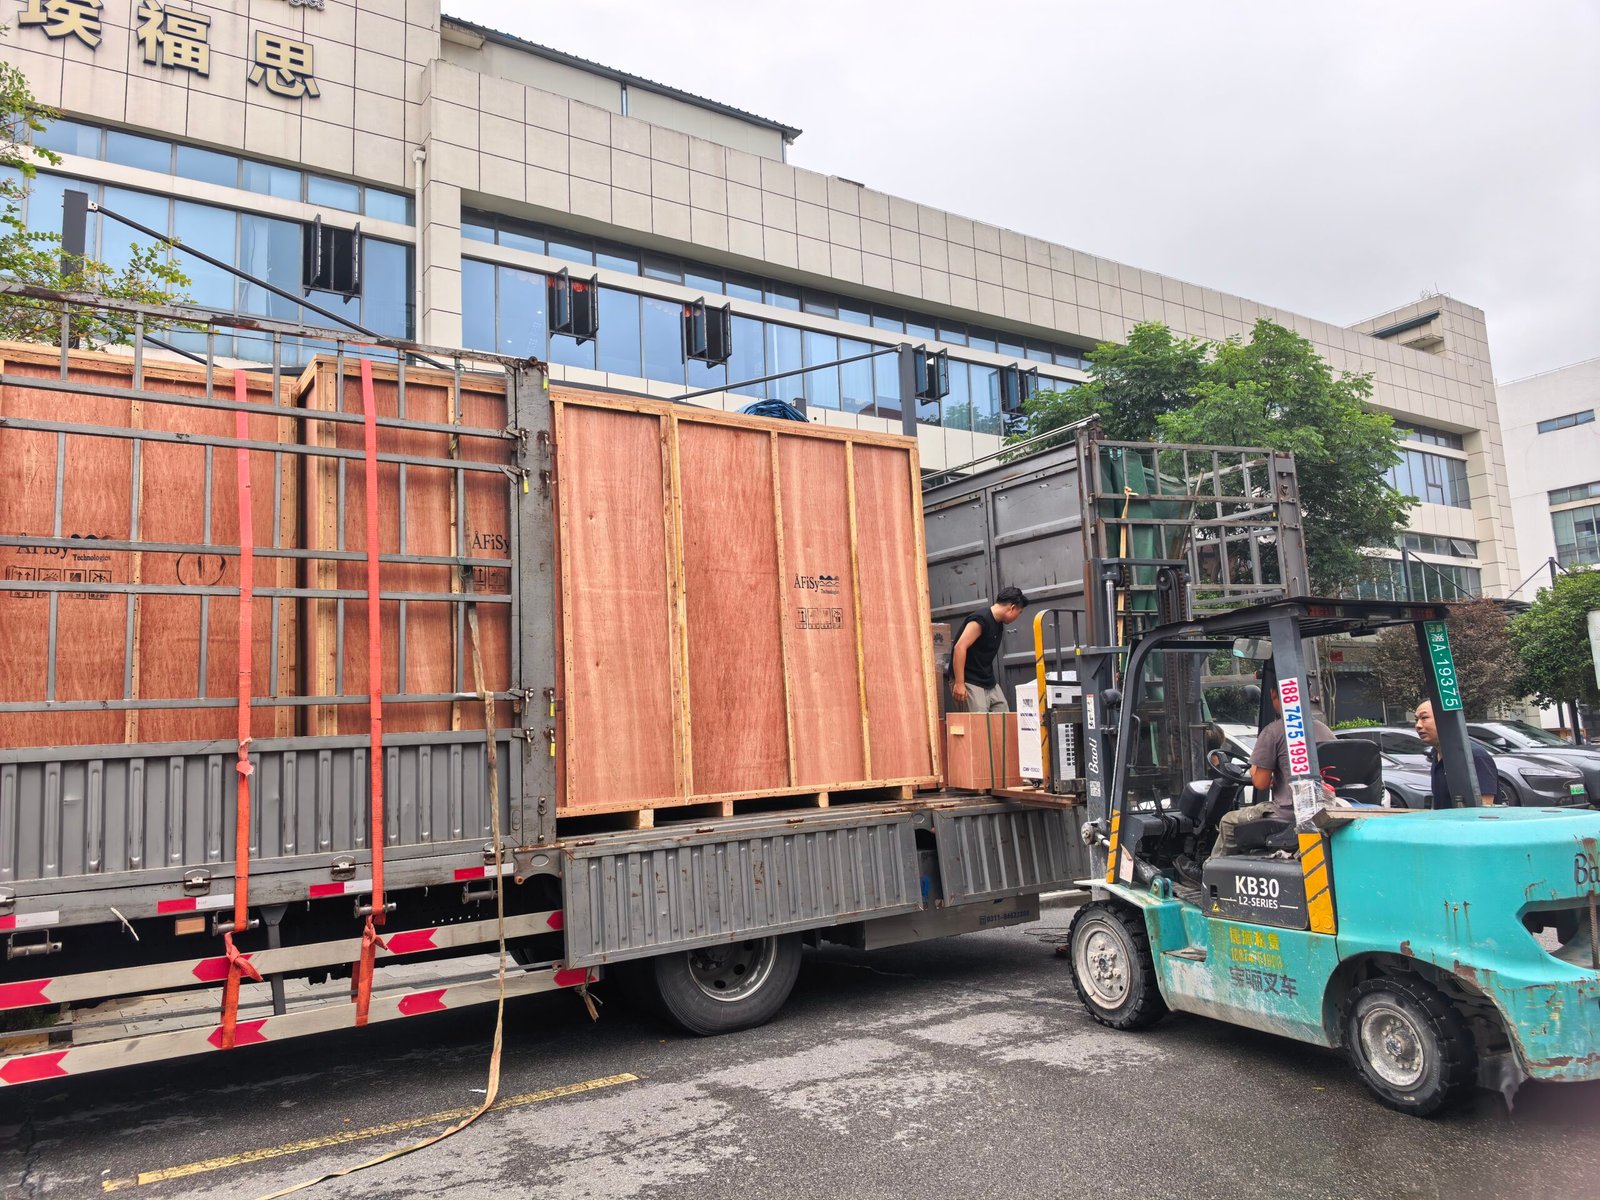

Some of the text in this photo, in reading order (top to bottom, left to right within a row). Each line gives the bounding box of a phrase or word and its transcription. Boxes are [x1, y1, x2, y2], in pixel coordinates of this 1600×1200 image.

[72, 554, 111, 562] Technologies
[1281, 680, 1299, 704] 188
[1285, 706, 1304, 739] 7475
[1289, 741, 1309, 774] 1993
[1235, 875, 1280, 898] KB30
[1238, 896, 1278, 909] L2-SERIES
